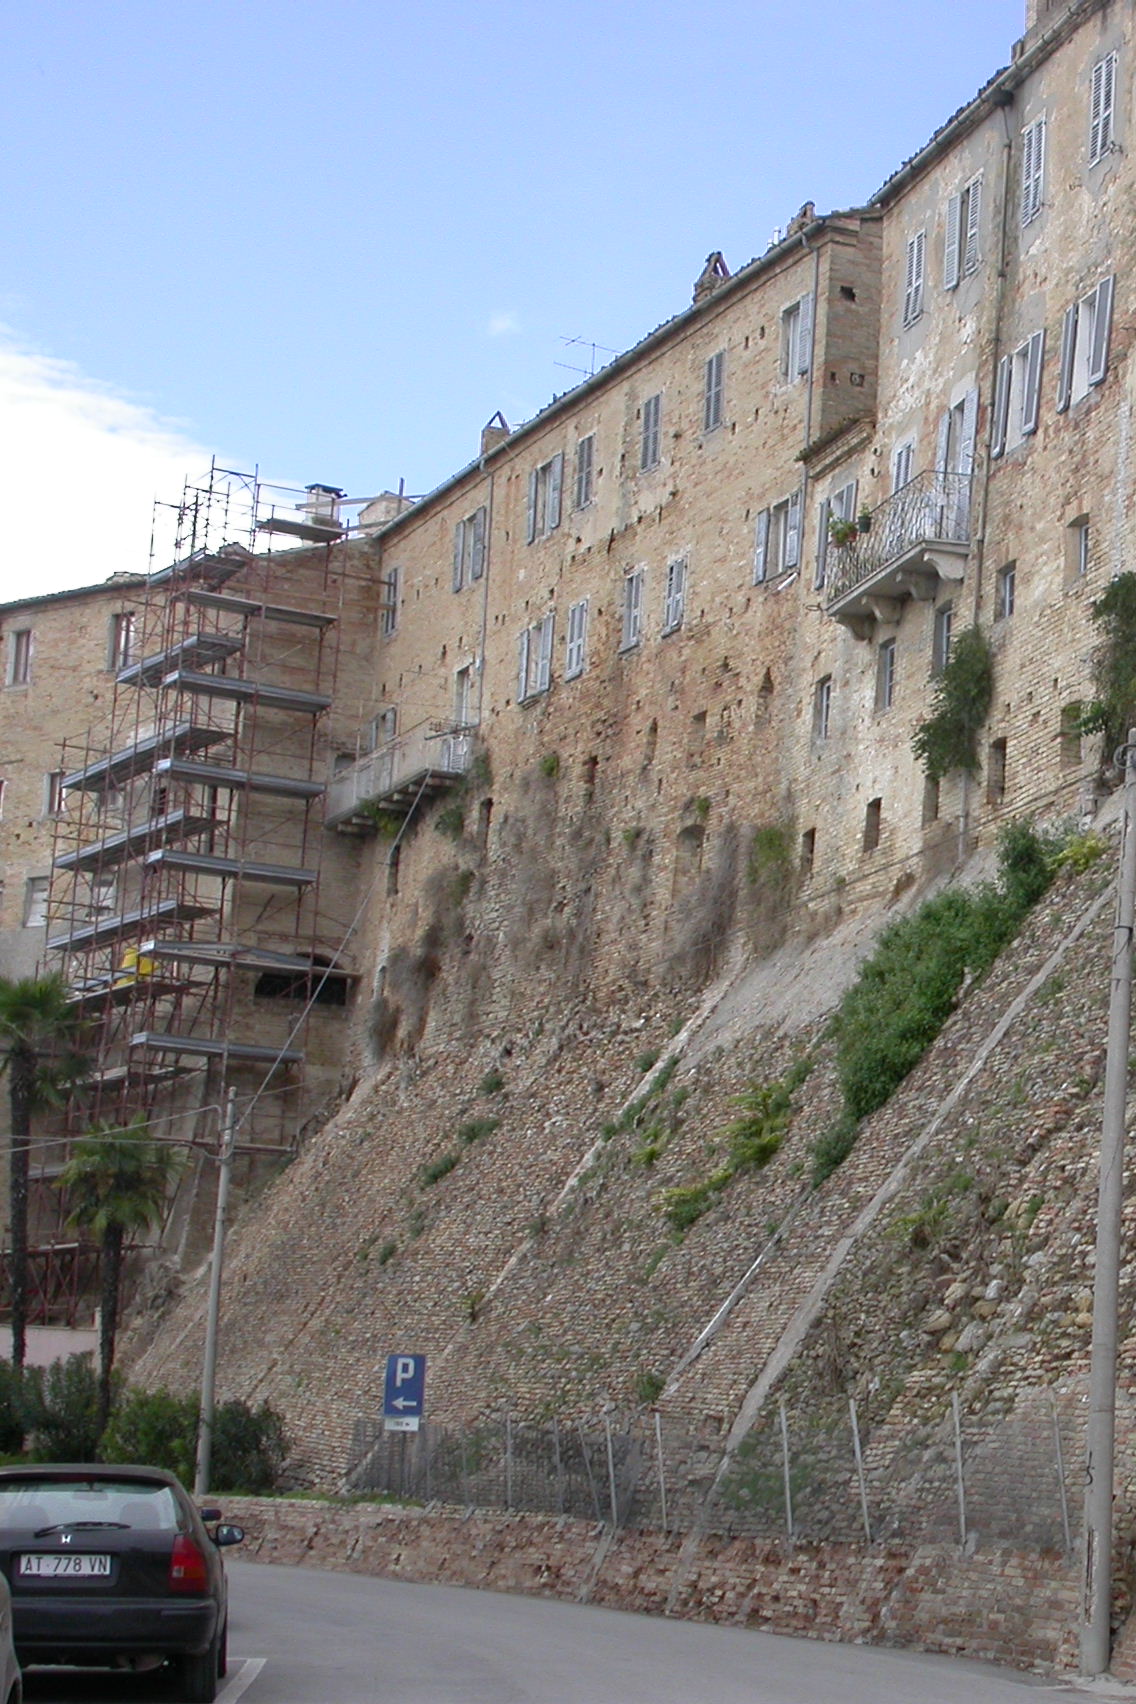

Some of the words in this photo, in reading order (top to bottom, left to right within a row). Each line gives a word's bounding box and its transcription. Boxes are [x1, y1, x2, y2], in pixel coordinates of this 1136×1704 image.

[396, 1357, 415, 1388] P
[24, 1556, 43, 1573] AT
[53, 1556, 82, 1573] 778
[89, 1556, 107, 1573] VN
